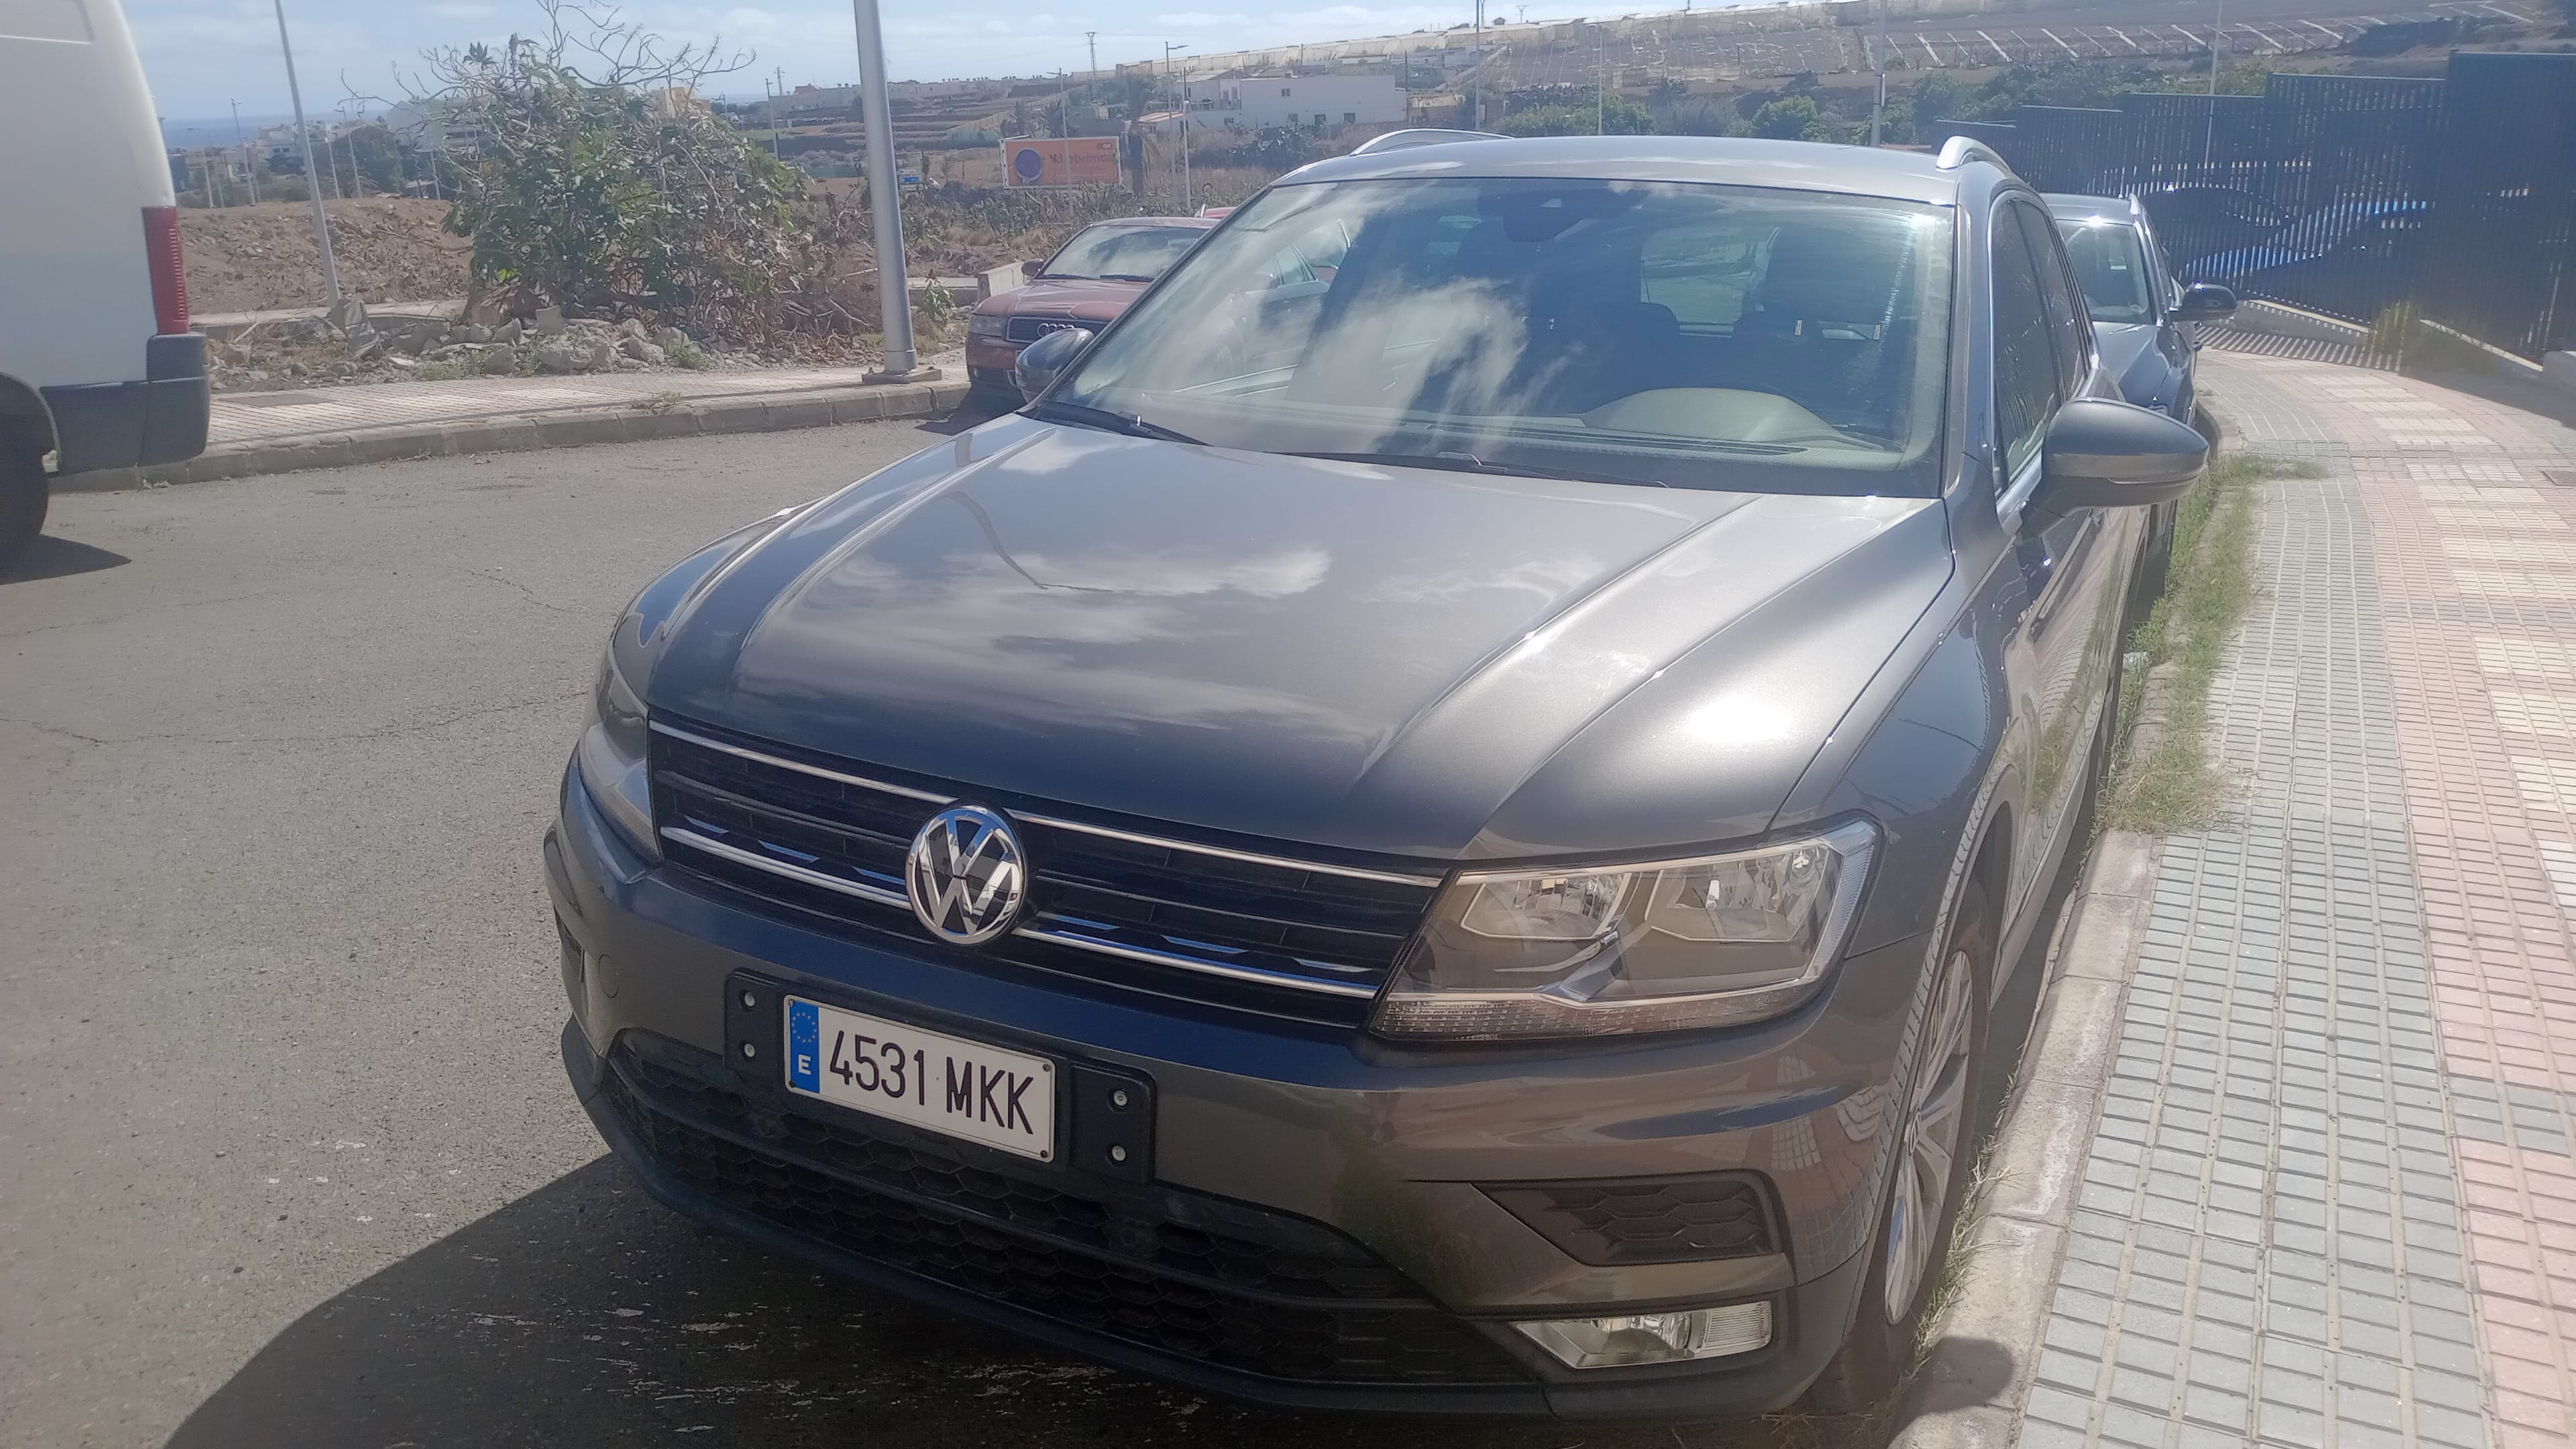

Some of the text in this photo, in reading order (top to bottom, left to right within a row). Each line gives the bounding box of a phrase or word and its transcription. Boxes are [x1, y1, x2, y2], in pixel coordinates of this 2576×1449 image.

[798, 1054, 812, 1075] E
[829, 1030, 1034, 1135] 4531 MKK
